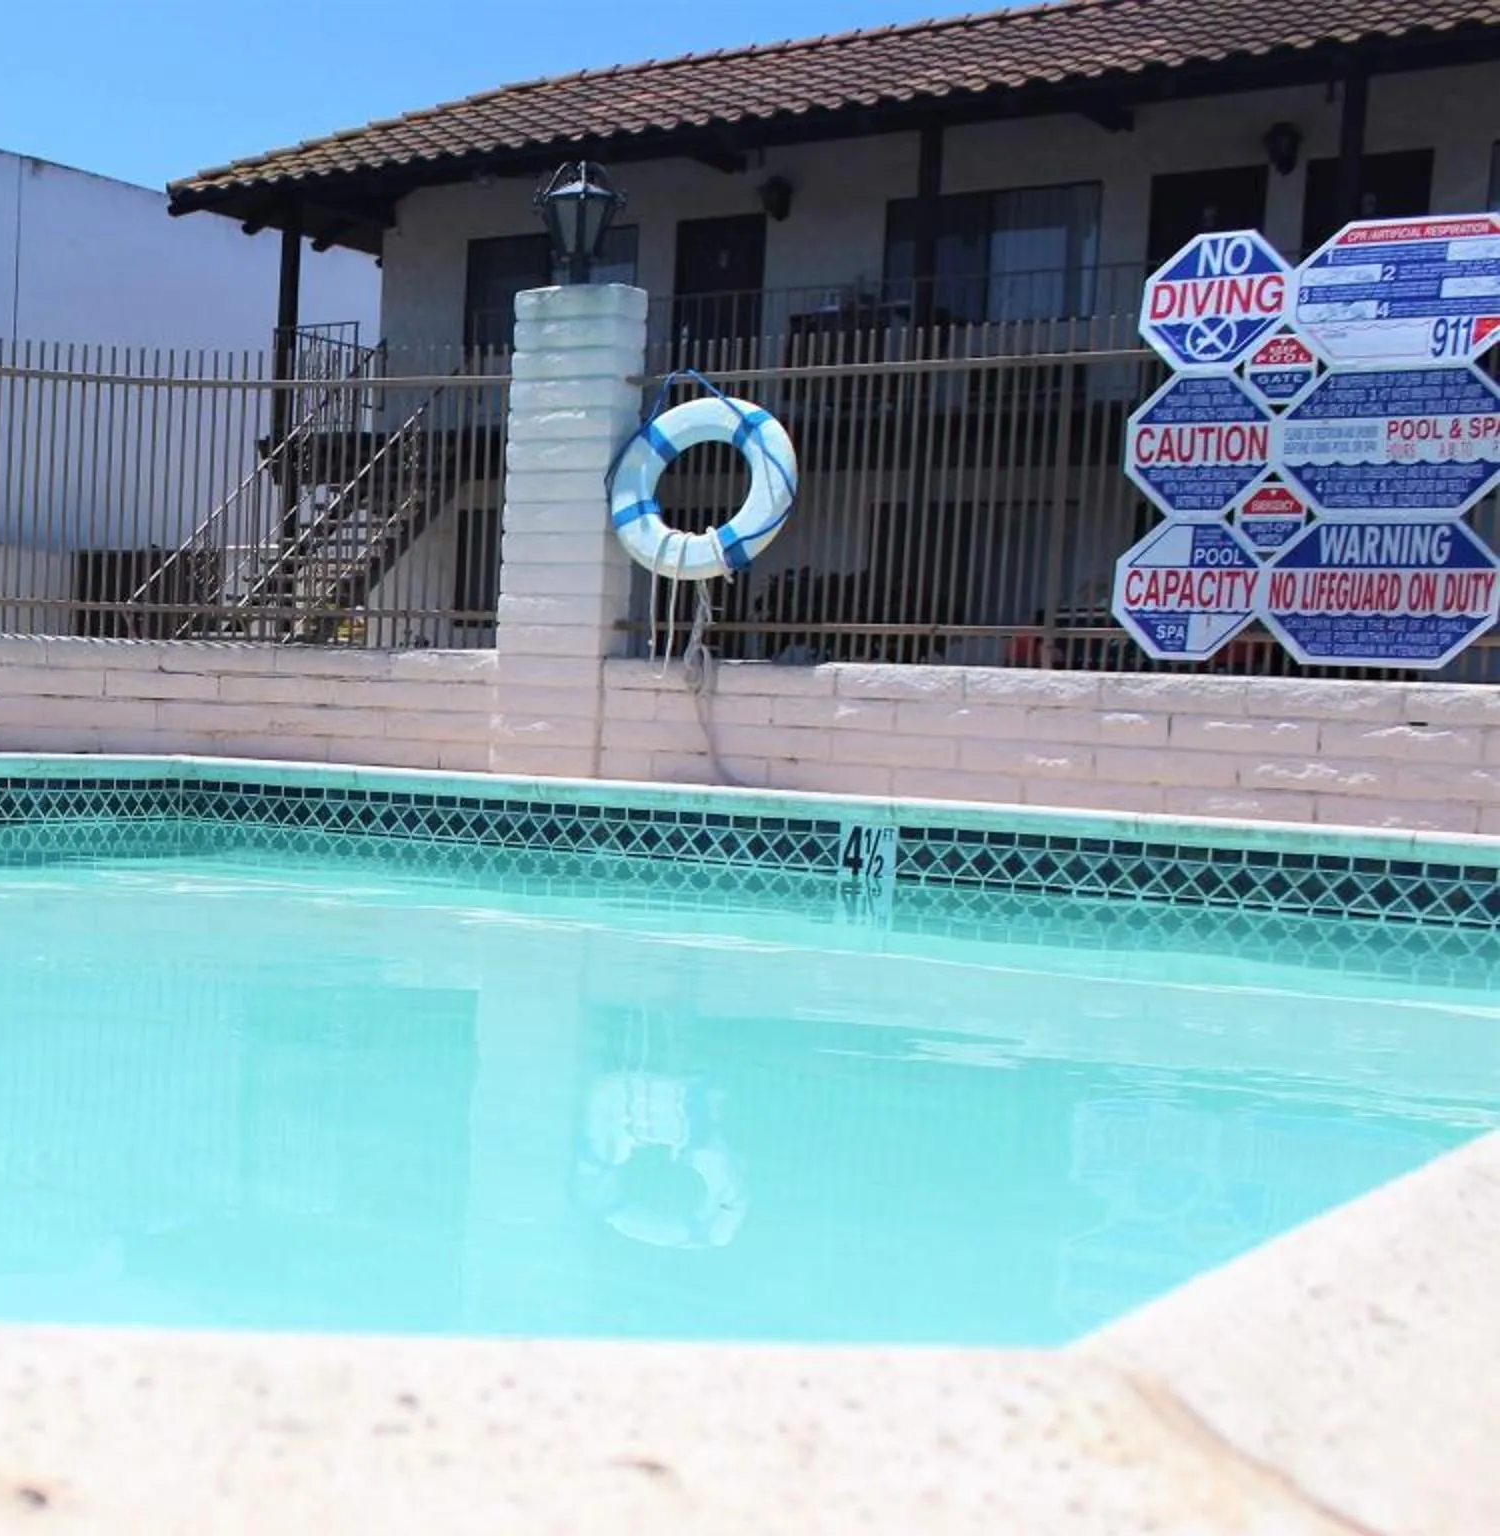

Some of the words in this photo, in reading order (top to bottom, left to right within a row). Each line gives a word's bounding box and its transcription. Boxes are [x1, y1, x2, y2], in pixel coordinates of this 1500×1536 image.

[1195, 236, 1254, 277] NO
[1383, 265, 1396, 281] 2
[1149, 274, 1286, 321] DIVING
[1376, 302, 1390, 318] 4
[1430, 316, 1474, 358] 911
[1257, 373, 1303, 385] GATE
[1135, 424, 1269, 463] CAUTION
[1386, 418, 1443, 441] POOL
[1449, 417, 1462, 439] &
[1193, 547, 1245, 566] POOL
[1318, 524, 1452, 566] WARNING
[1124, 569, 1260, 609] CAPACITY
[1267, 571, 1298, 610] NO
[1300, 571, 1402, 612] LIFEGUARD
[1407, 572, 1438, 612] ON
[1442, 572, 1497, 613] DUTY
[1155, 624, 1186, 640] SPA
